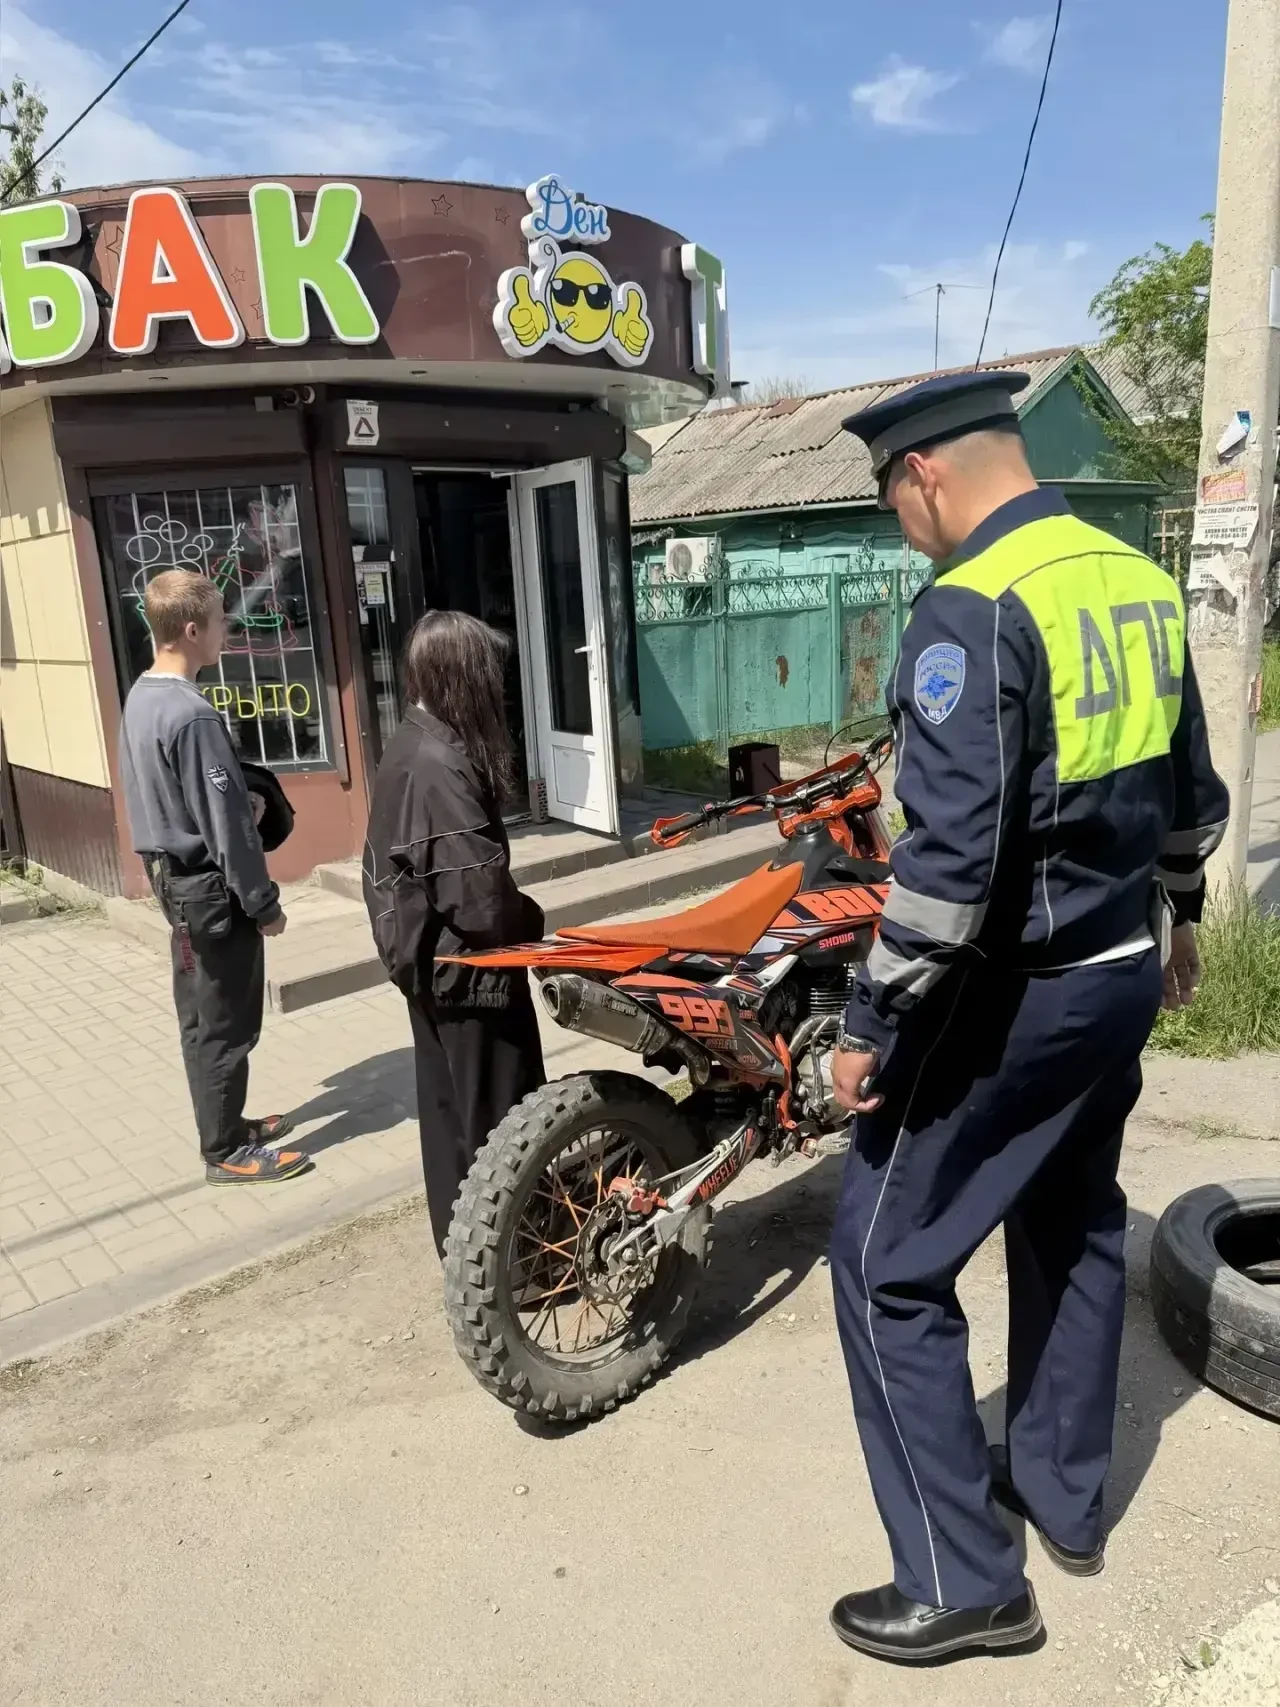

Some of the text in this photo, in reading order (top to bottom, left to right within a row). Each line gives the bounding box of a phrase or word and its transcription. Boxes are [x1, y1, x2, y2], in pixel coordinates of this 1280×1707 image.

[533, 178, 608, 235] Ден
[0, 182, 381, 375] БАК
[928, 705, 948, 720] МВД
[819, 932, 855, 949] SHOWA
